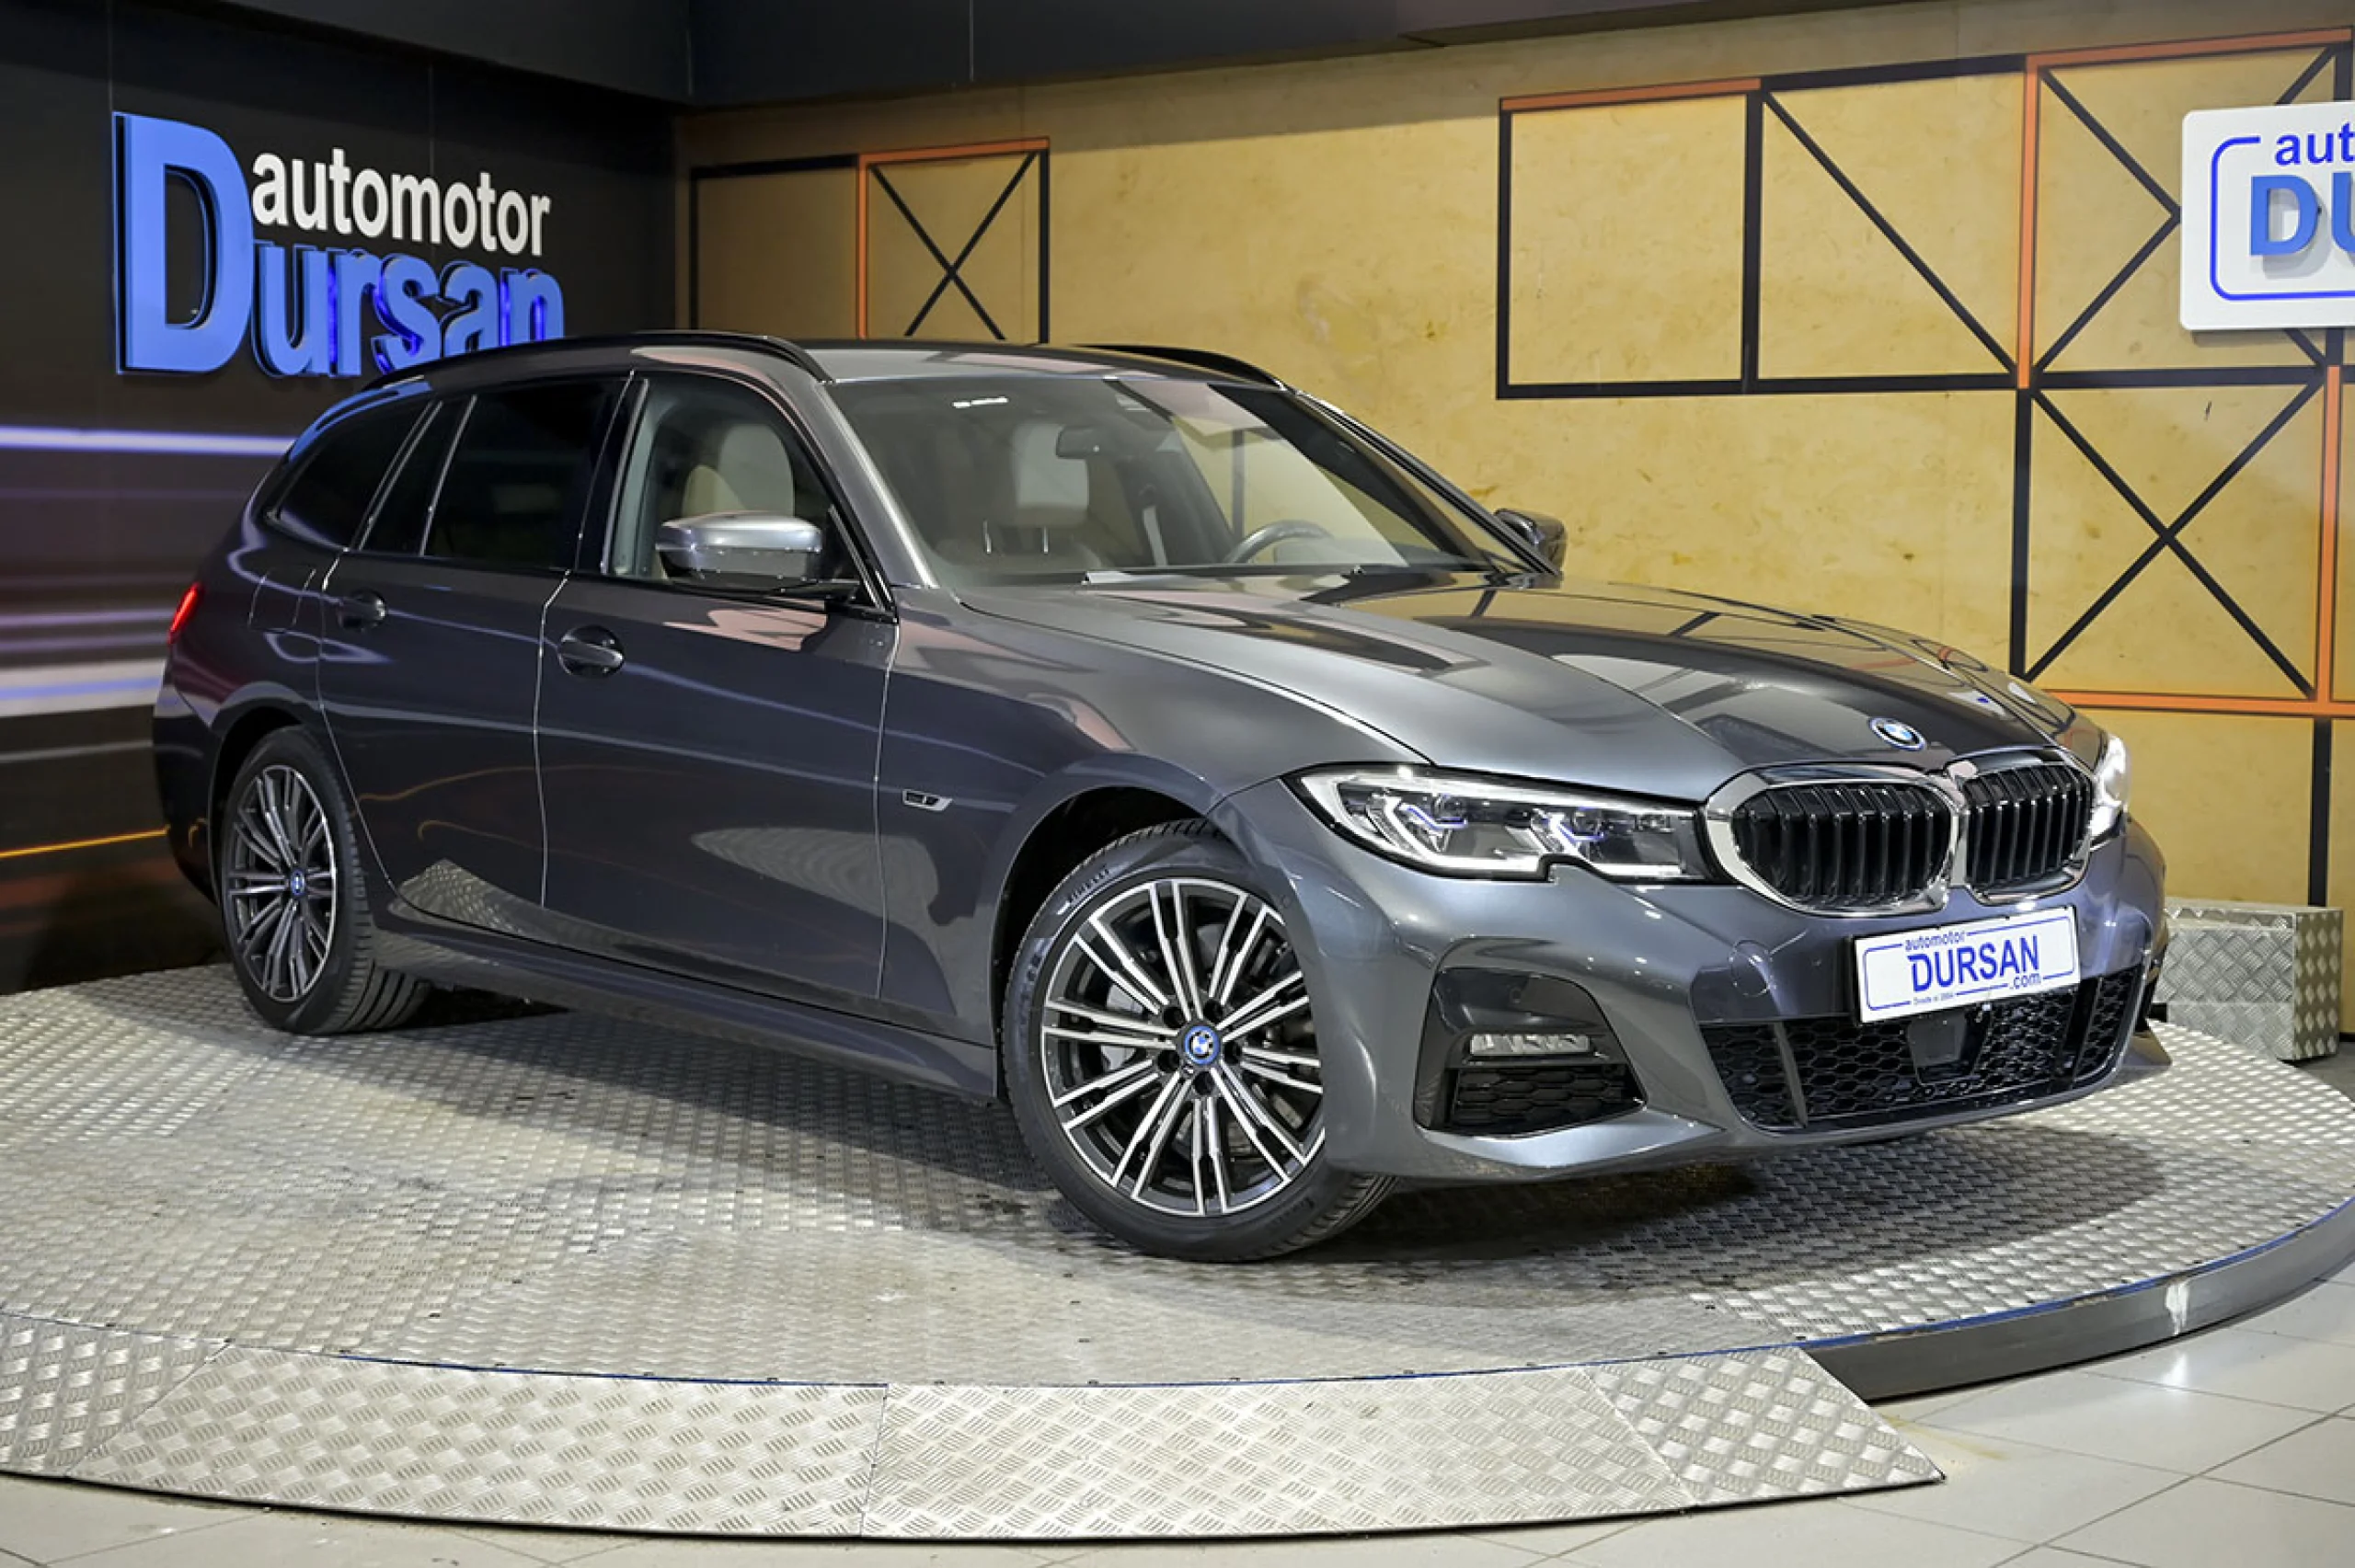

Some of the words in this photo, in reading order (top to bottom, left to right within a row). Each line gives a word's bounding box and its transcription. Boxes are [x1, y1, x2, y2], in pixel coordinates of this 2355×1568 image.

[252, 147, 551, 256] automotor
[112, 111, 565, 378] Dursan
[1905, 932, 1965, 952] automotor
[1907, 934, 2039, 992] DURSAN
[2009, 972, 2042, 990] .com
